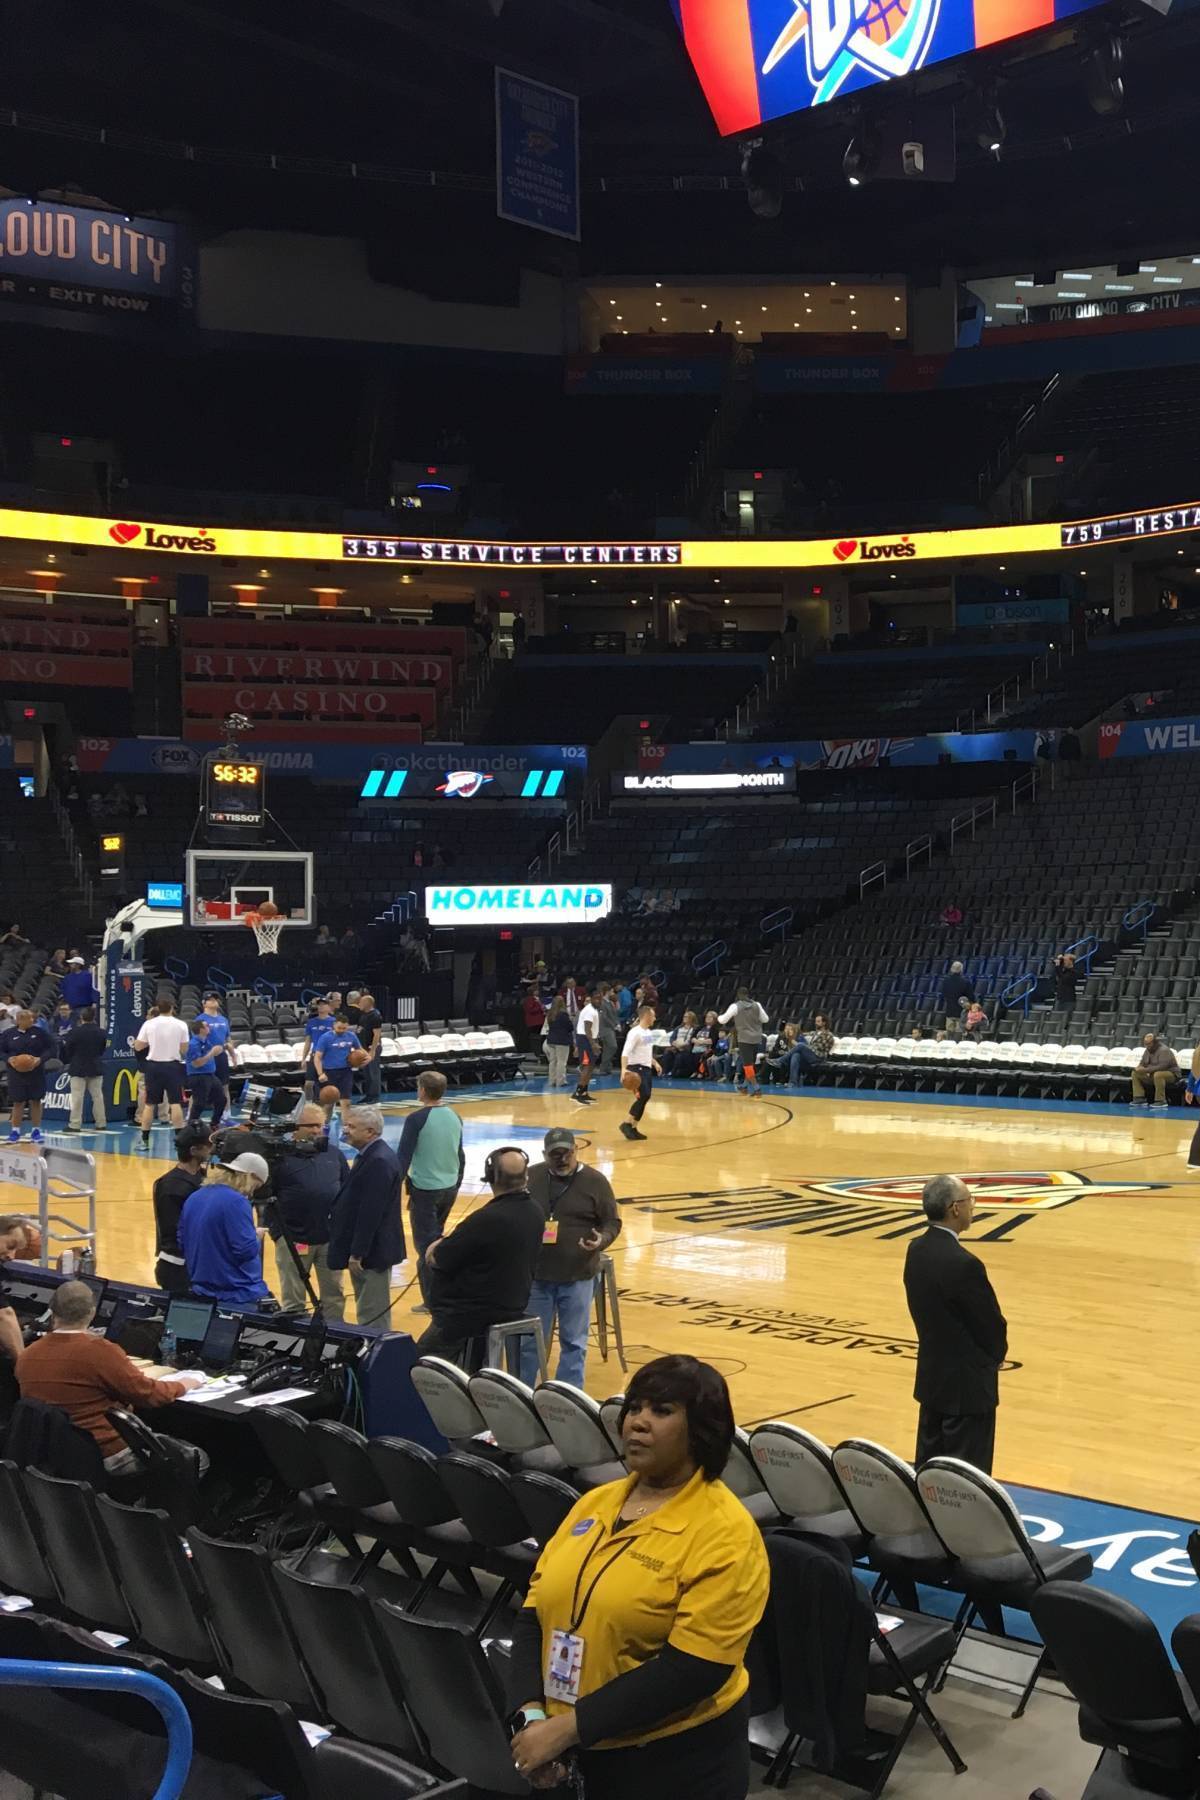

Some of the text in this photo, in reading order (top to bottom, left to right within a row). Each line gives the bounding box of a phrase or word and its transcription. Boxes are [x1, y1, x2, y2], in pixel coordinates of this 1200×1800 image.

[0, 211, 167, 284] OUD CITY
[49, 286, 96, 304] EXIT
[102, 295, 149, 311] NOW
[784, 368, 881, 379] THUNDER BOX
[1065, 526, 1103, 545] 759
[347, 542, 679, 563] 355 SERVICE CENTERS
[194, 655, 442, 681] RIVERWIND
[235, 690, 387, 712] CASINO
[1100, 724, 1122, 737] 104
[80, 739, 110, 751] 102
[560, 747, 587, 758] 102
[641, 746, 666, 758] 103
[624, 775, 672, 789] BLACK
[224, 813, 261, 822] TISSOT
[432, 888, 604, 910] HOMELAND
[132, 980, 141, 1017] devon
